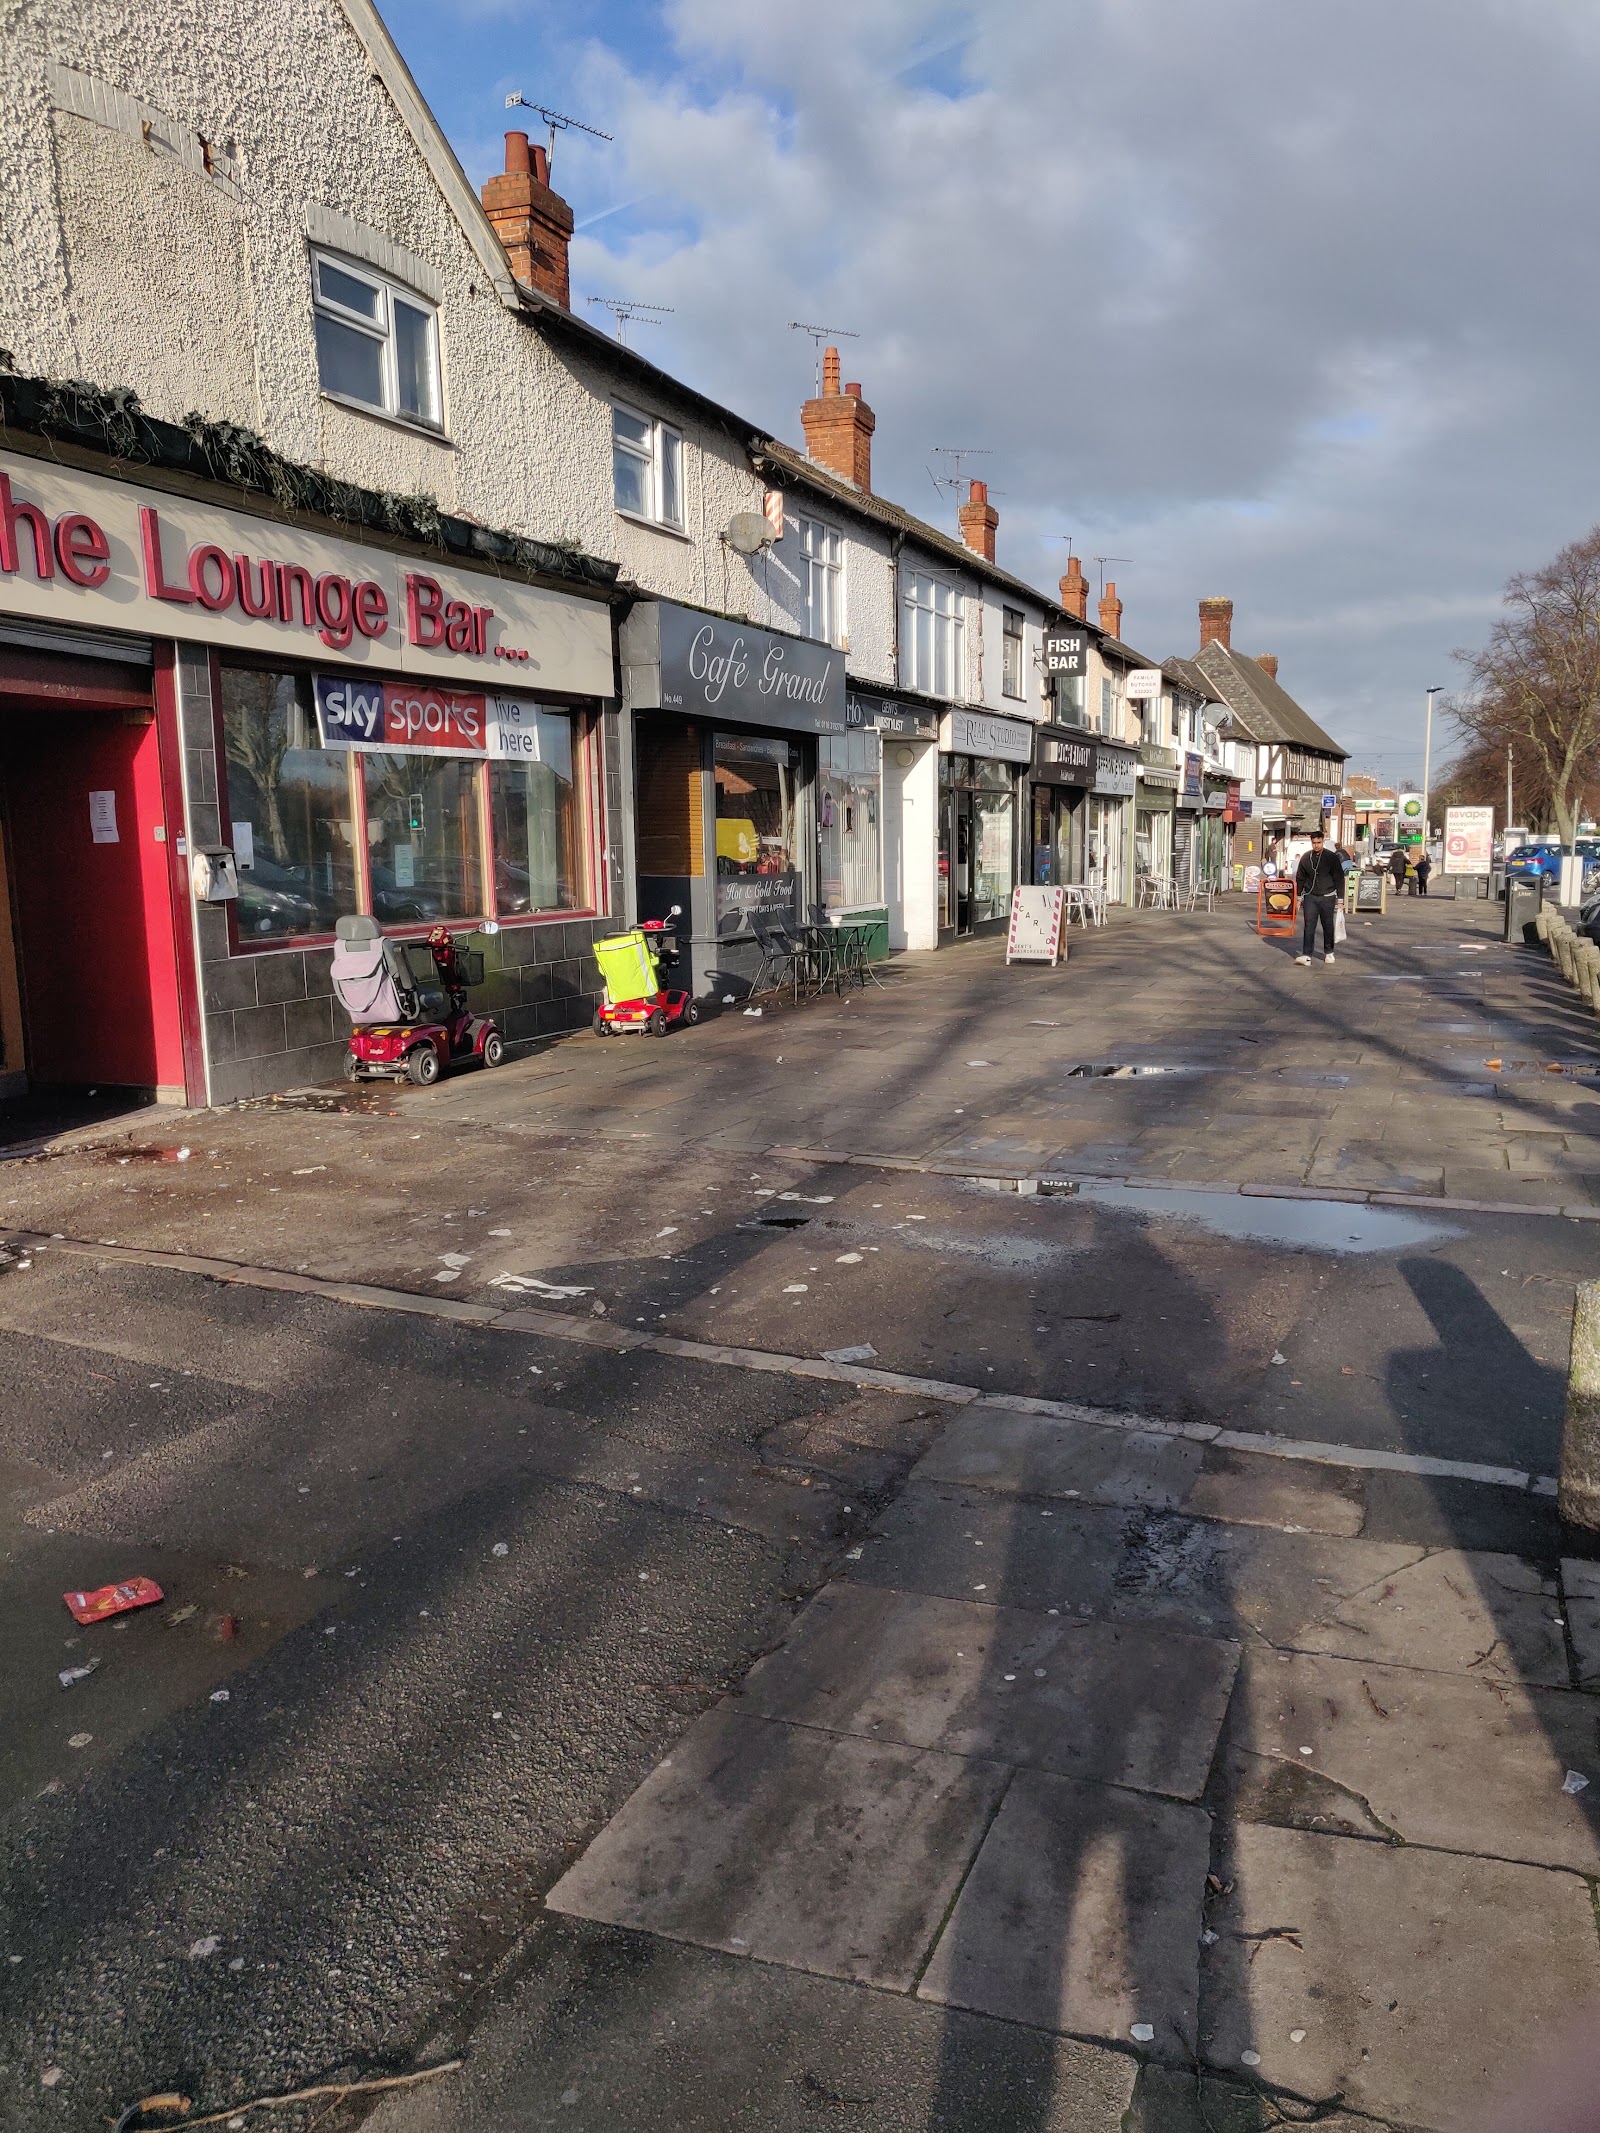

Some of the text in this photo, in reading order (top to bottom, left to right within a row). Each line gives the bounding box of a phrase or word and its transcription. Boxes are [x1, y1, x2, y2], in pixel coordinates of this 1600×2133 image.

[139, 507, 388, 649] Lounge
[1047, 638, 1080, 653] FISH
[688, 625, 831, 705] Café Grand
[1048, 655, 1079, 670] BAR
[325, 683, 479, 739] sky sports
[493, 695, 520, 723] live
[499, 725, 533, 753] here
[715, 739, 737, 751] Breakfast
[1451, 839, 1465, 851] £1
